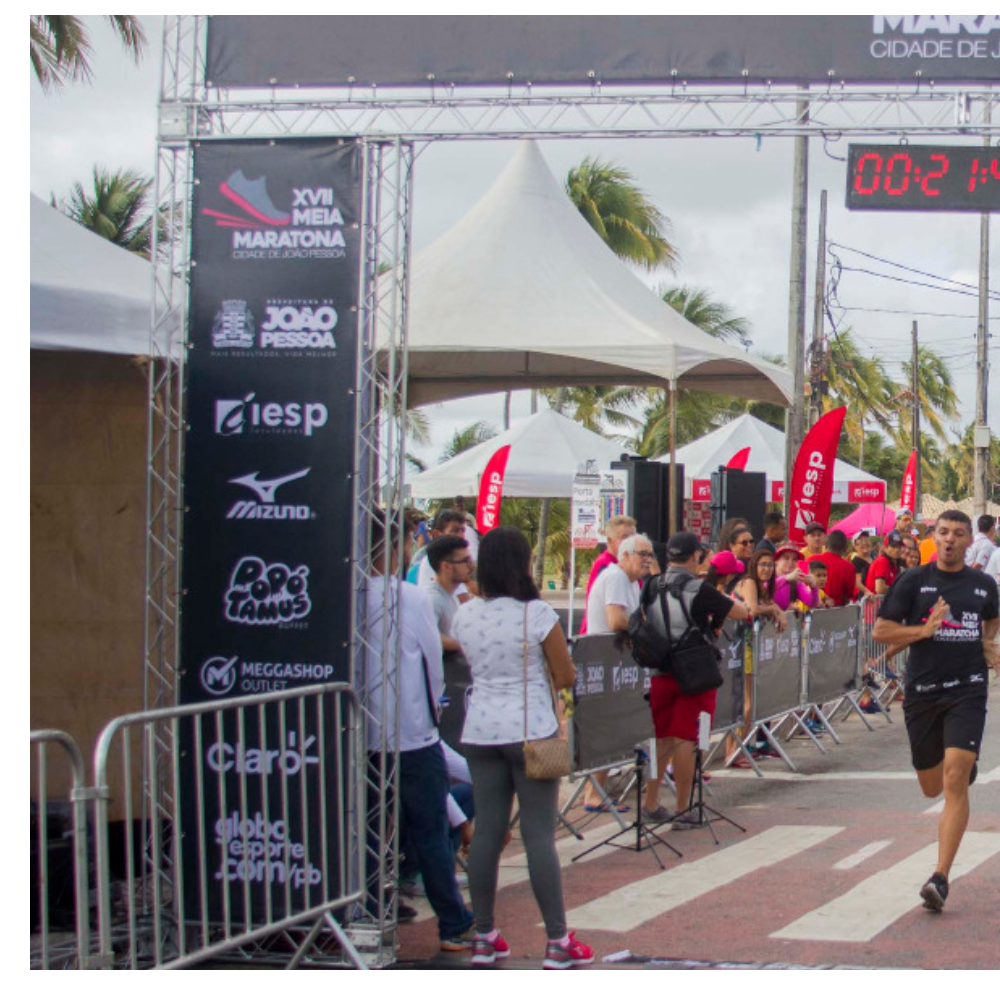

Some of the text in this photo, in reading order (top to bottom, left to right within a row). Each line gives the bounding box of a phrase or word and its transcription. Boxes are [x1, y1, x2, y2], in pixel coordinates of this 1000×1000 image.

[870, 40, 952, 59] CIDADE
[957, 41, 988, 59] DE
[293, 187, 333, 206] XVII
[293, 208, 344, 226] MEIA
[233, 230, 346, 249] MARATONA
[262, 305, 338, 331] JOÃO
[260, 331, 336, 348] PESSOA
[252, 401, 328, 436] iesp
[801, 451, 827, 506] iesp
[485, 472, 503, 510] iesp
[227, 501, 310, 519] MIZUNO
[241, 662, 333, 679] MEGGASHOP
